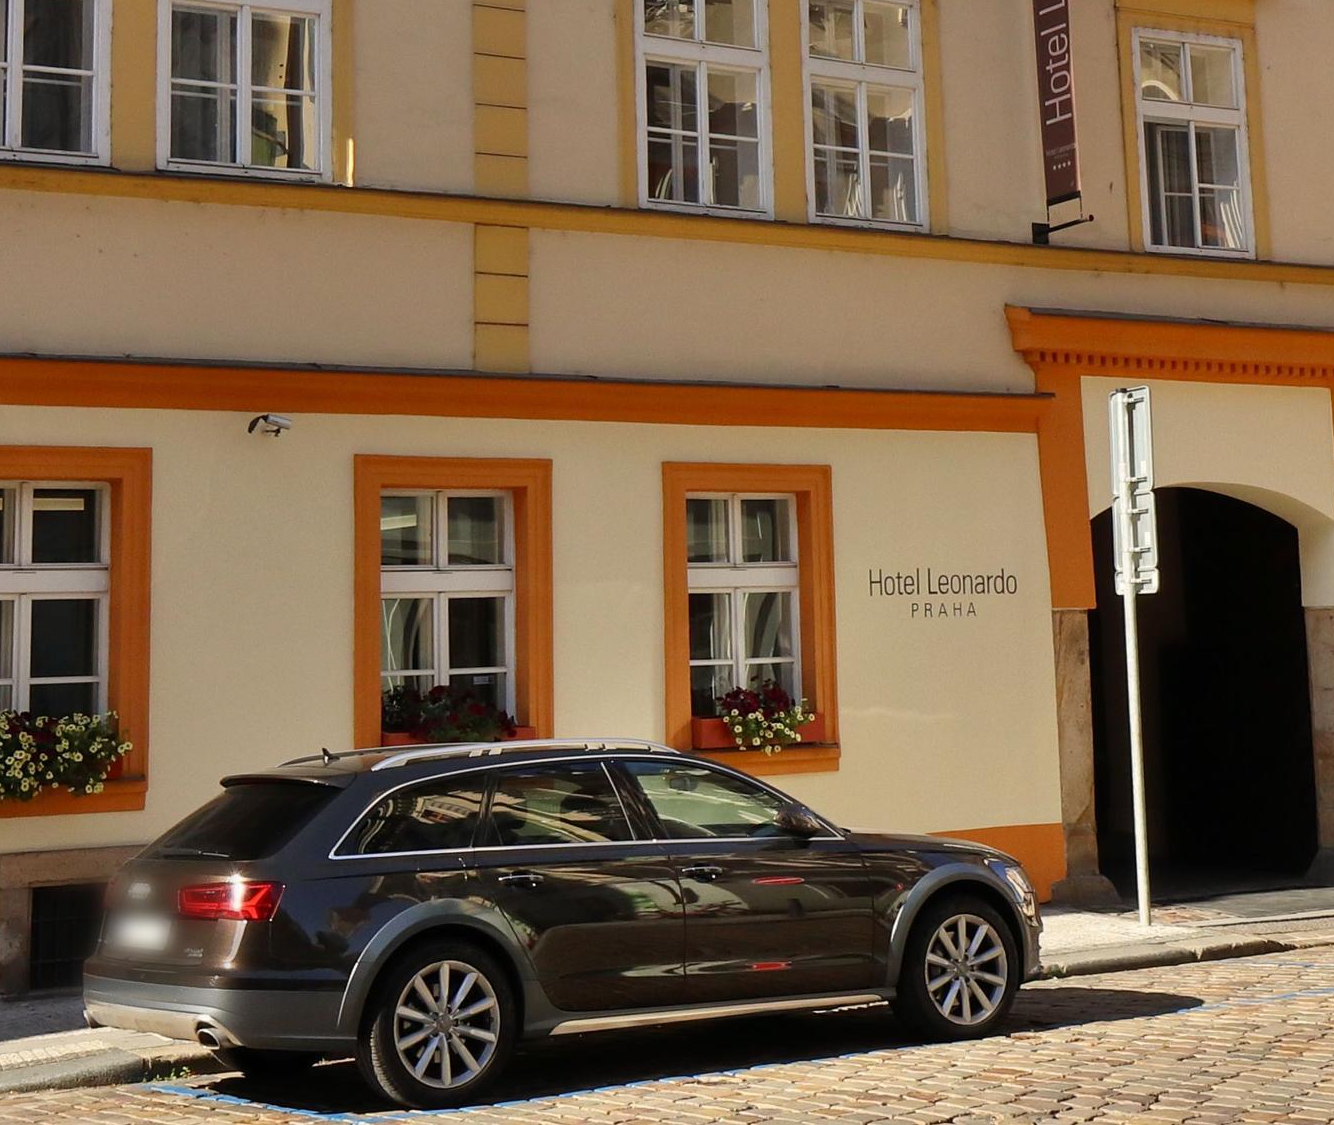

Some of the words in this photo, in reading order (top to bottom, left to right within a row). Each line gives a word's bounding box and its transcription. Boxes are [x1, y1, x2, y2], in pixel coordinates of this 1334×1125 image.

[1041, 22, 1072, 125] Hotel
[869, 568, 920, 596] Hotel
[927, 568, 1017, 595] Leonardo
[911, 602, 977, 618] PRAHA
